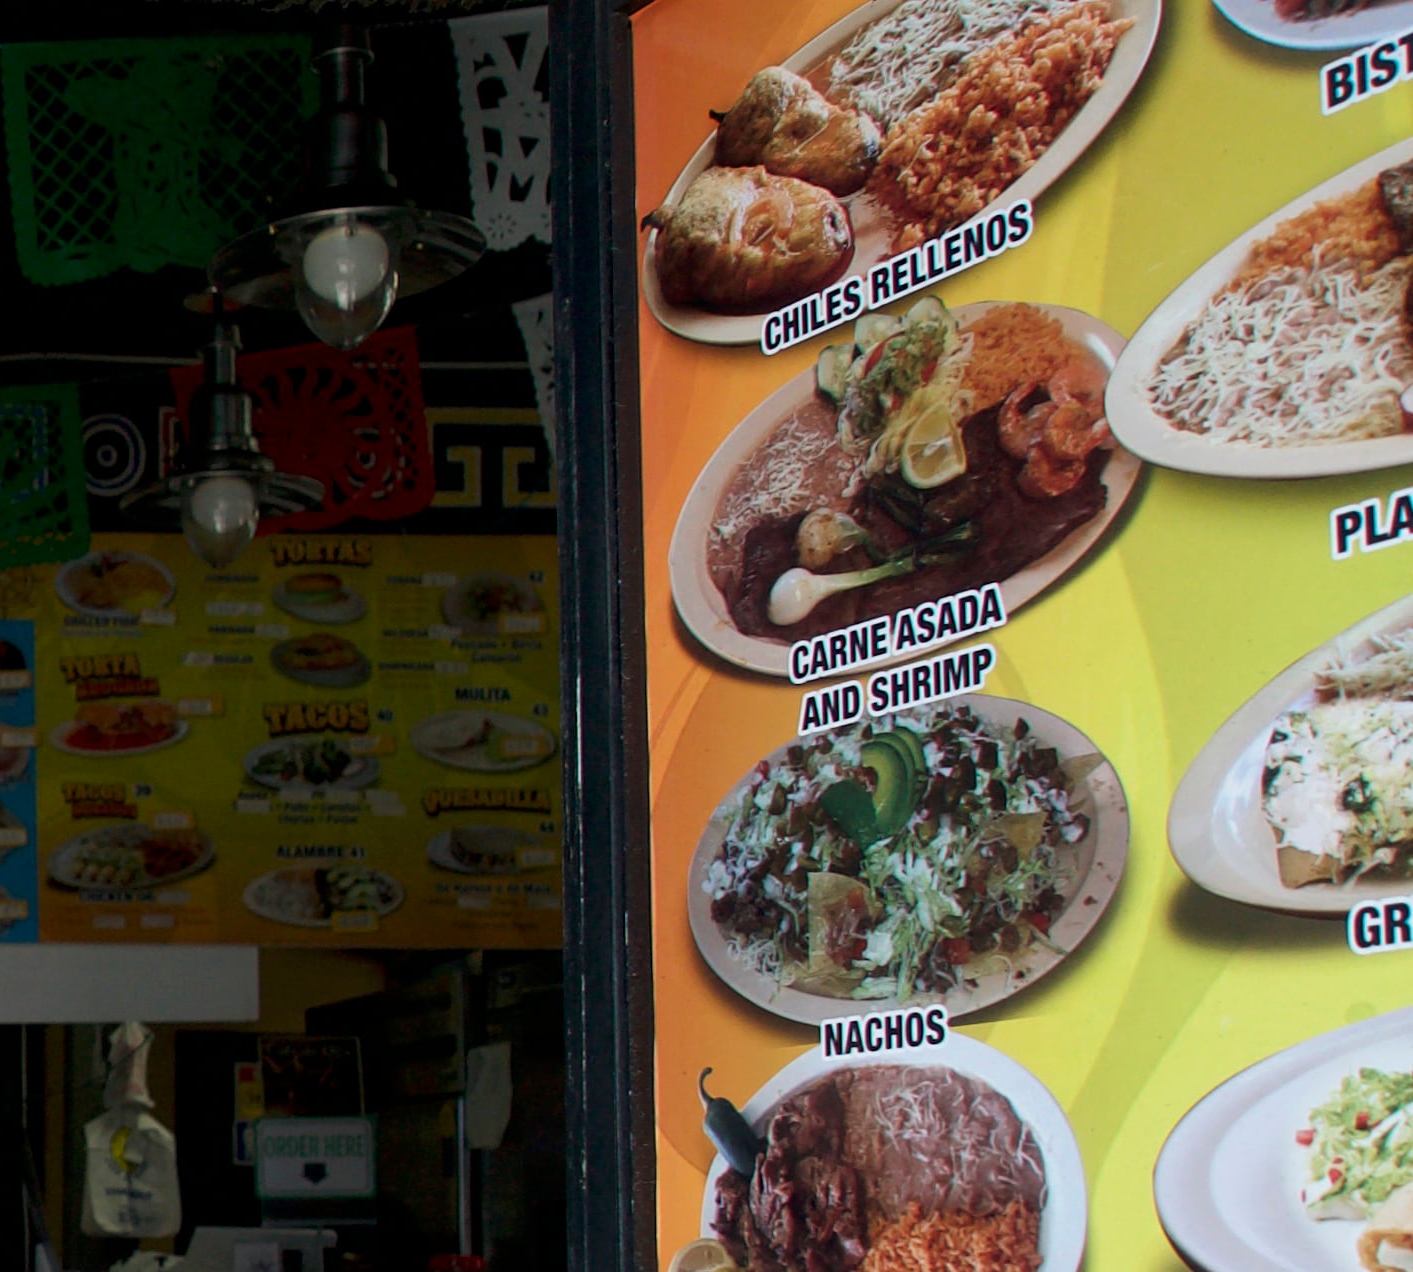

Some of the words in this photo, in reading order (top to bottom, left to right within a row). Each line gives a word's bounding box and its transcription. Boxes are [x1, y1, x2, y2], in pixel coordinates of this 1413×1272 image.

[764, 280, 861, 352] CHILES
[871, 204, 1031, 300] RELLENOS
[269, 539, 372, 567] TORTAS
[791, 620, 887, 682] CARNE
[896, 590, 1004, 651] ASADA
[455, 688, 511, 702] MULITA
[801, 683, 861, 731] AND
[872, 649, 993, 713] SHRIMP
[263, 701, 370, 736] TACOS
[823, 1008, 947, 1057] NACHOS
[263, 1135, 320, 1160] ORDER
[324, 1136, 367, 1159] HERE
